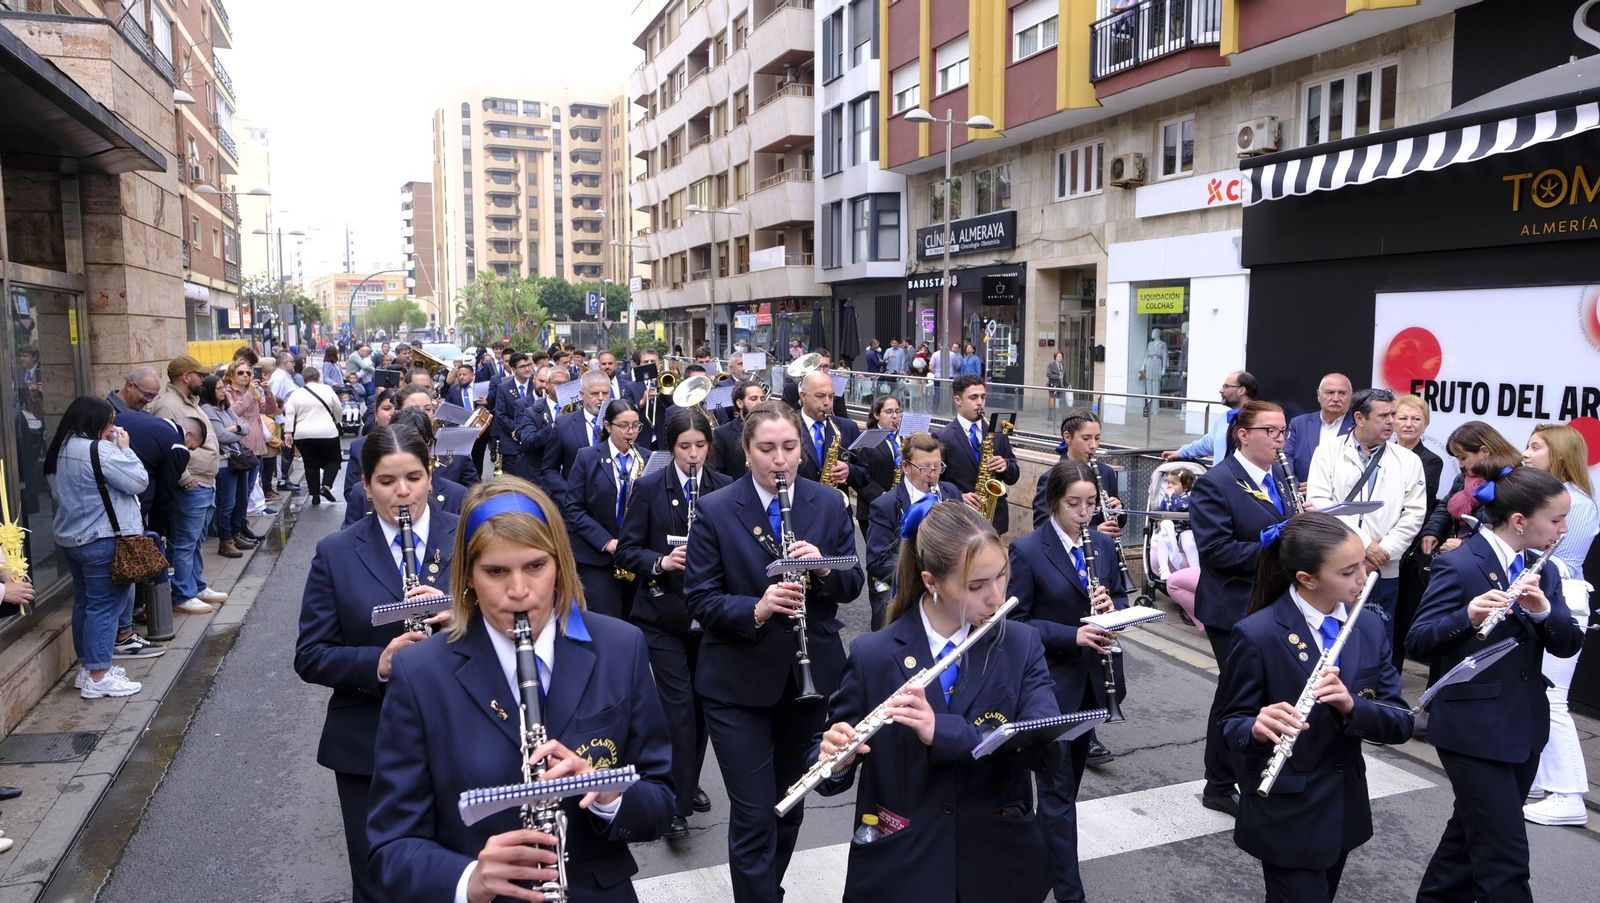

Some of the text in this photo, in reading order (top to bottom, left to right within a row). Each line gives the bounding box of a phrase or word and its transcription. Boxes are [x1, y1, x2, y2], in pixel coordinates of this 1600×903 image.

[1521, 216, 1598, 236] ALMERÍA
[925, 222, 1005, 248] CLÍNIA ALMERAYA
[1140, 293, 1180, 302] LIQUIDACIÓN
[1146, 301, 1174, 310] COLCHAS
[1410, 379, 1490, 416] FRUTO
[1497, 383, 1550, 420] DEL
[974, 716, 985, 726] EL
[576, 744, 589, 756] EL
